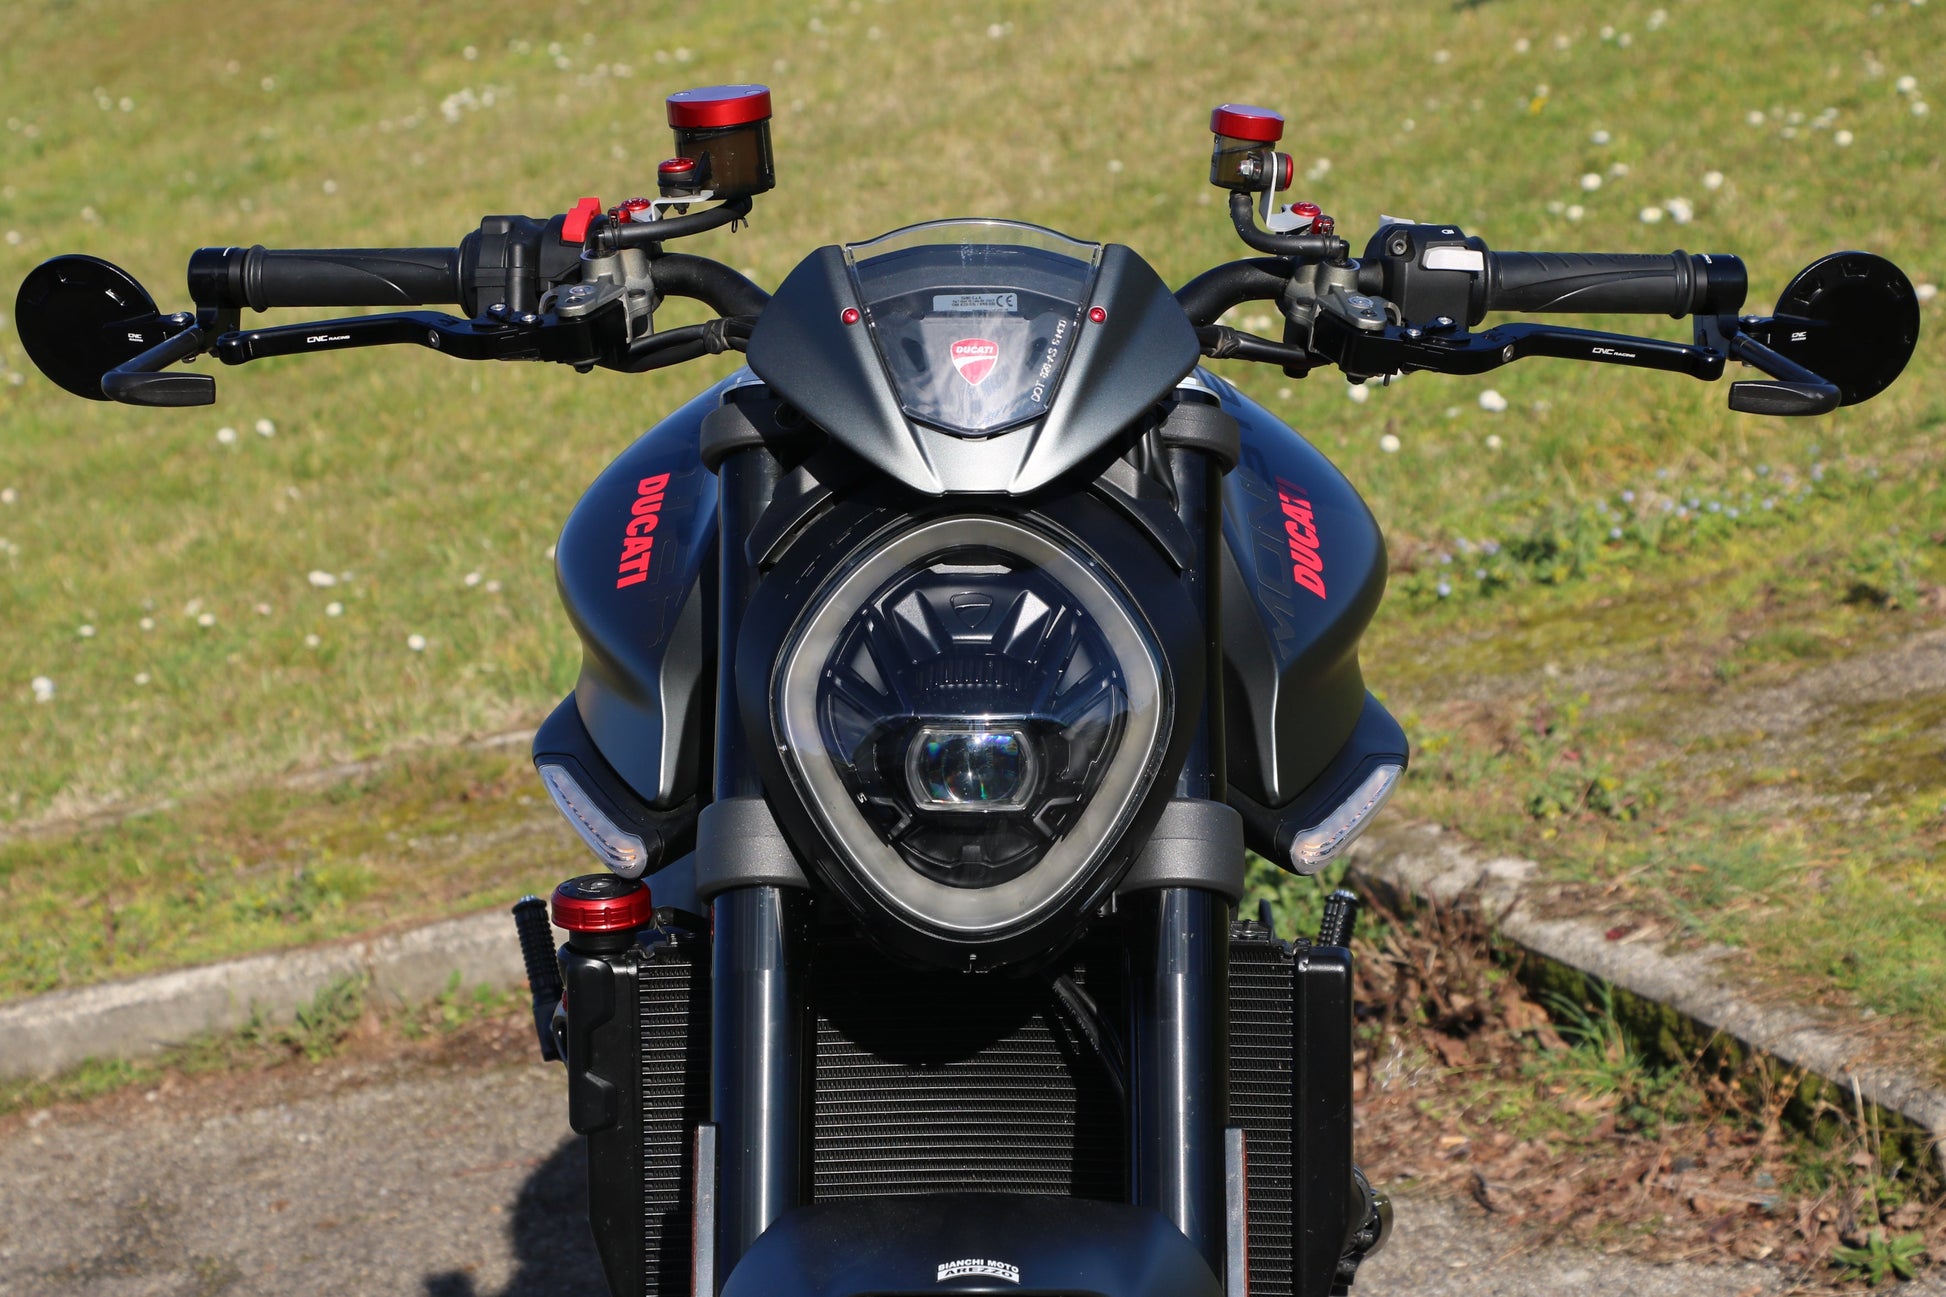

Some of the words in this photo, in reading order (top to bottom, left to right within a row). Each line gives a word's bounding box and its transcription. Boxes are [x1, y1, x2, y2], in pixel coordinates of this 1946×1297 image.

[307, 335, 328, 343] CNC
[1592, 347, 1615, 355] CNC
[1031, 380, 1045, 402] DOT
[616, 473, 670, 589] DUCATI
[1275, 475, 1327, 600] DUCATI
[938, 1259, 984, 1271] BIANCHI
[987, 1260, 1019, 1273] MOTO
[945, 1267, 1013, 1278] AREZZO
